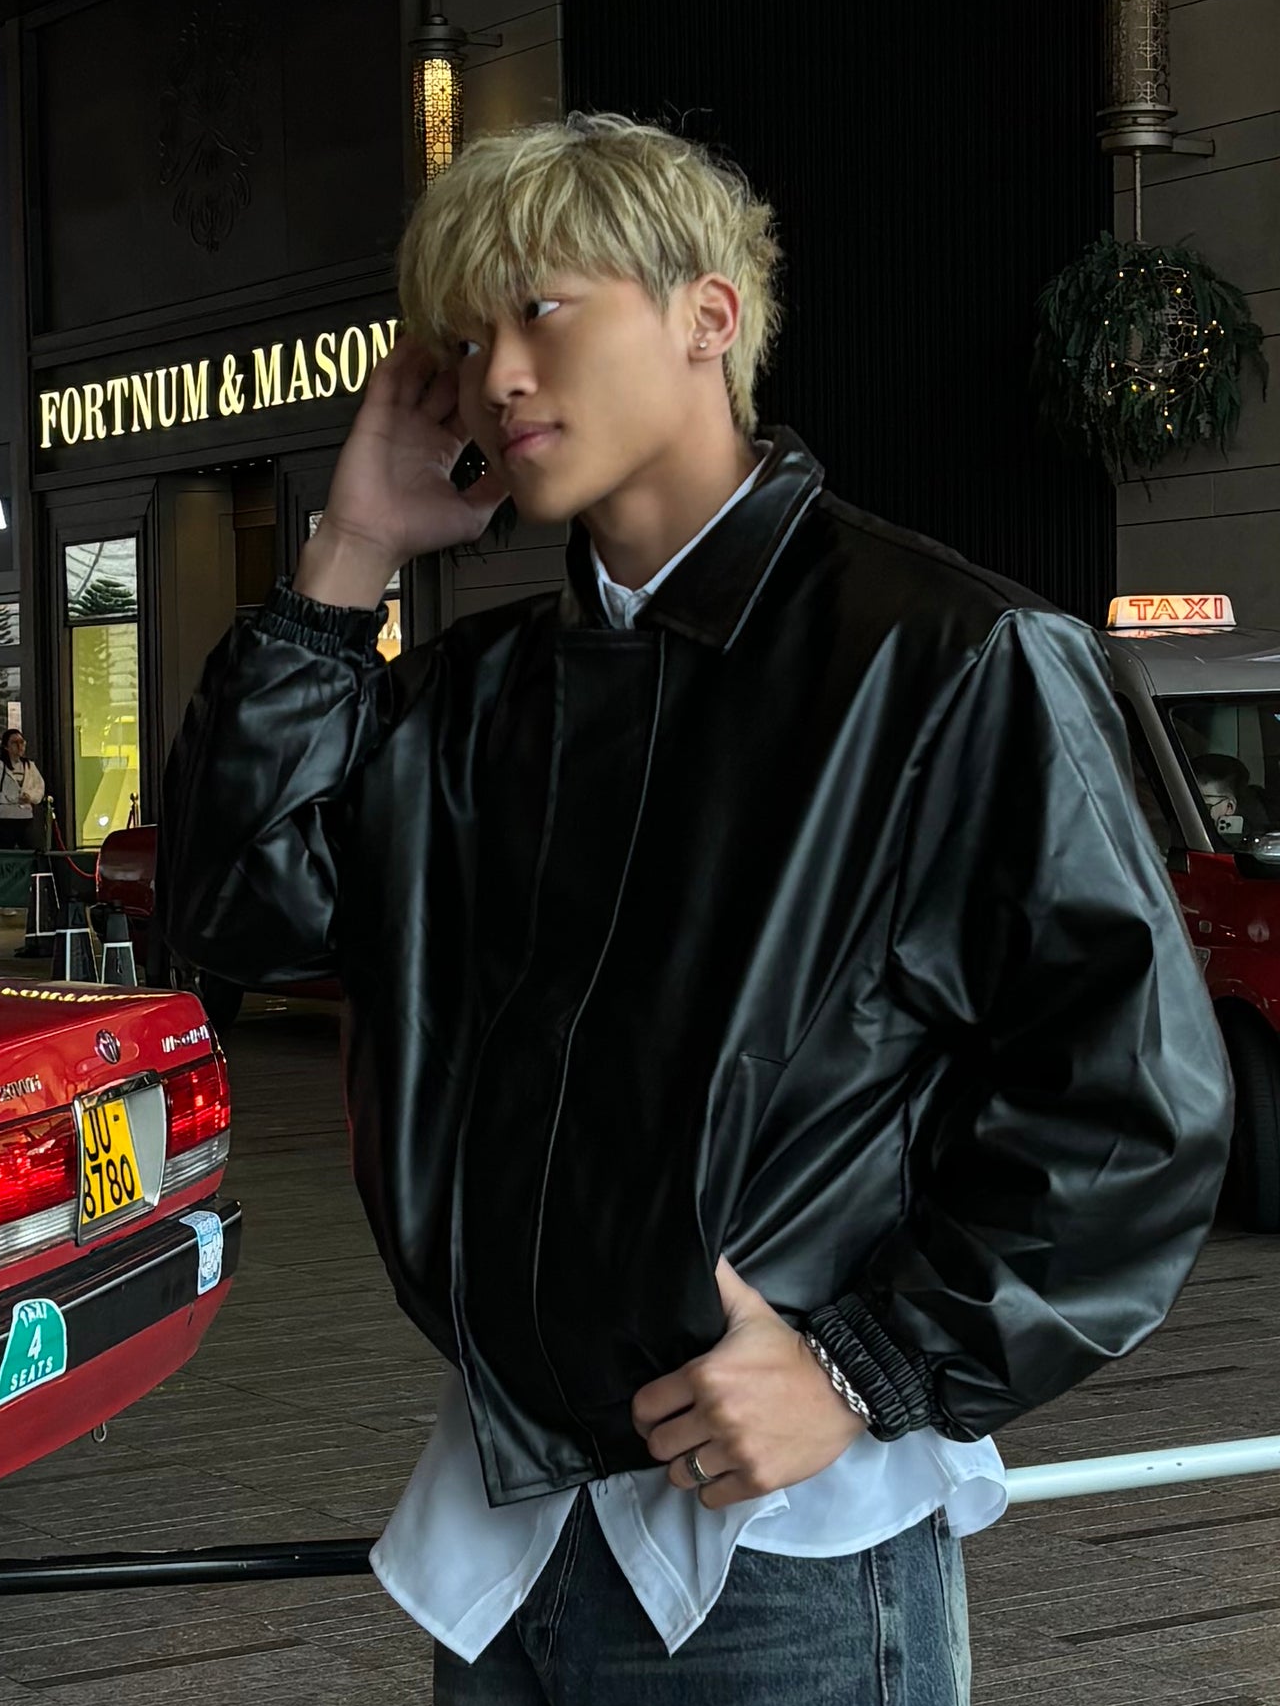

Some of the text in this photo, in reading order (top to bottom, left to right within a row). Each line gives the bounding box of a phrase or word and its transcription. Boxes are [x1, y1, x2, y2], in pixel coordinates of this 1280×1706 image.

[39, 318, 399, 449] FORTNUM & MASON
[1128, 597, 1224, 621] TAXI
[19, 1301, 48, 1329] TAXI
[27, 1323, 43, 1360] 4
[10, 1355, 54, 1392] SEATS
